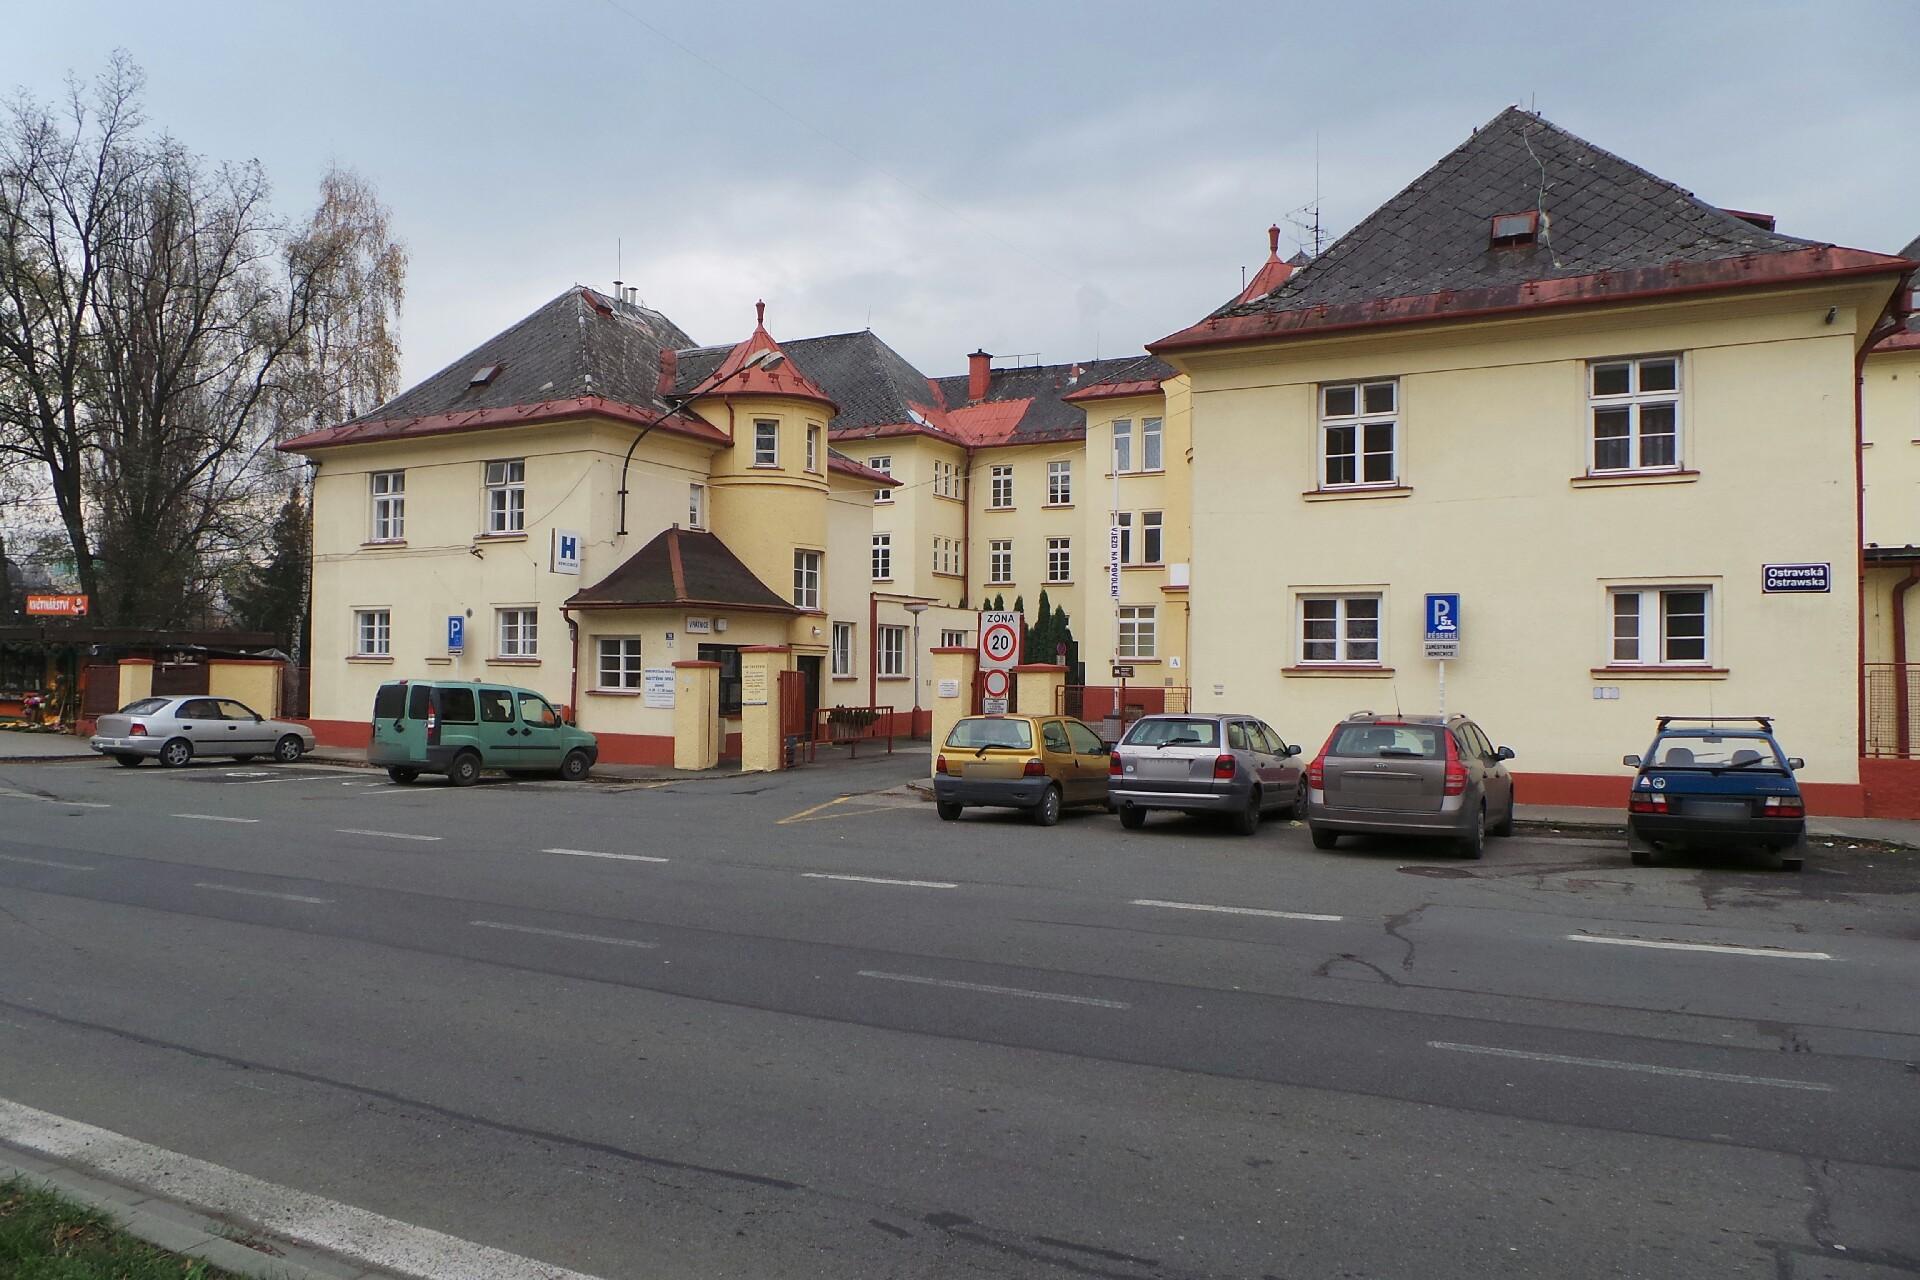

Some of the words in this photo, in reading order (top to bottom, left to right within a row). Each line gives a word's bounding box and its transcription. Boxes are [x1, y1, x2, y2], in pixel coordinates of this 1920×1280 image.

[561, 535, 576, 560] H
[1768, 568, 1824, 577] Ostravská
[1768, 578, 1825, 586] Ostrawska
[987, 612, 1015, 623] ZÓNA
[1434, 600, 1450, 624] P
[451, 620, 460, 638] P
[992, 635, 1009, 650] 20
[1172, 658, 1179, 666] A
